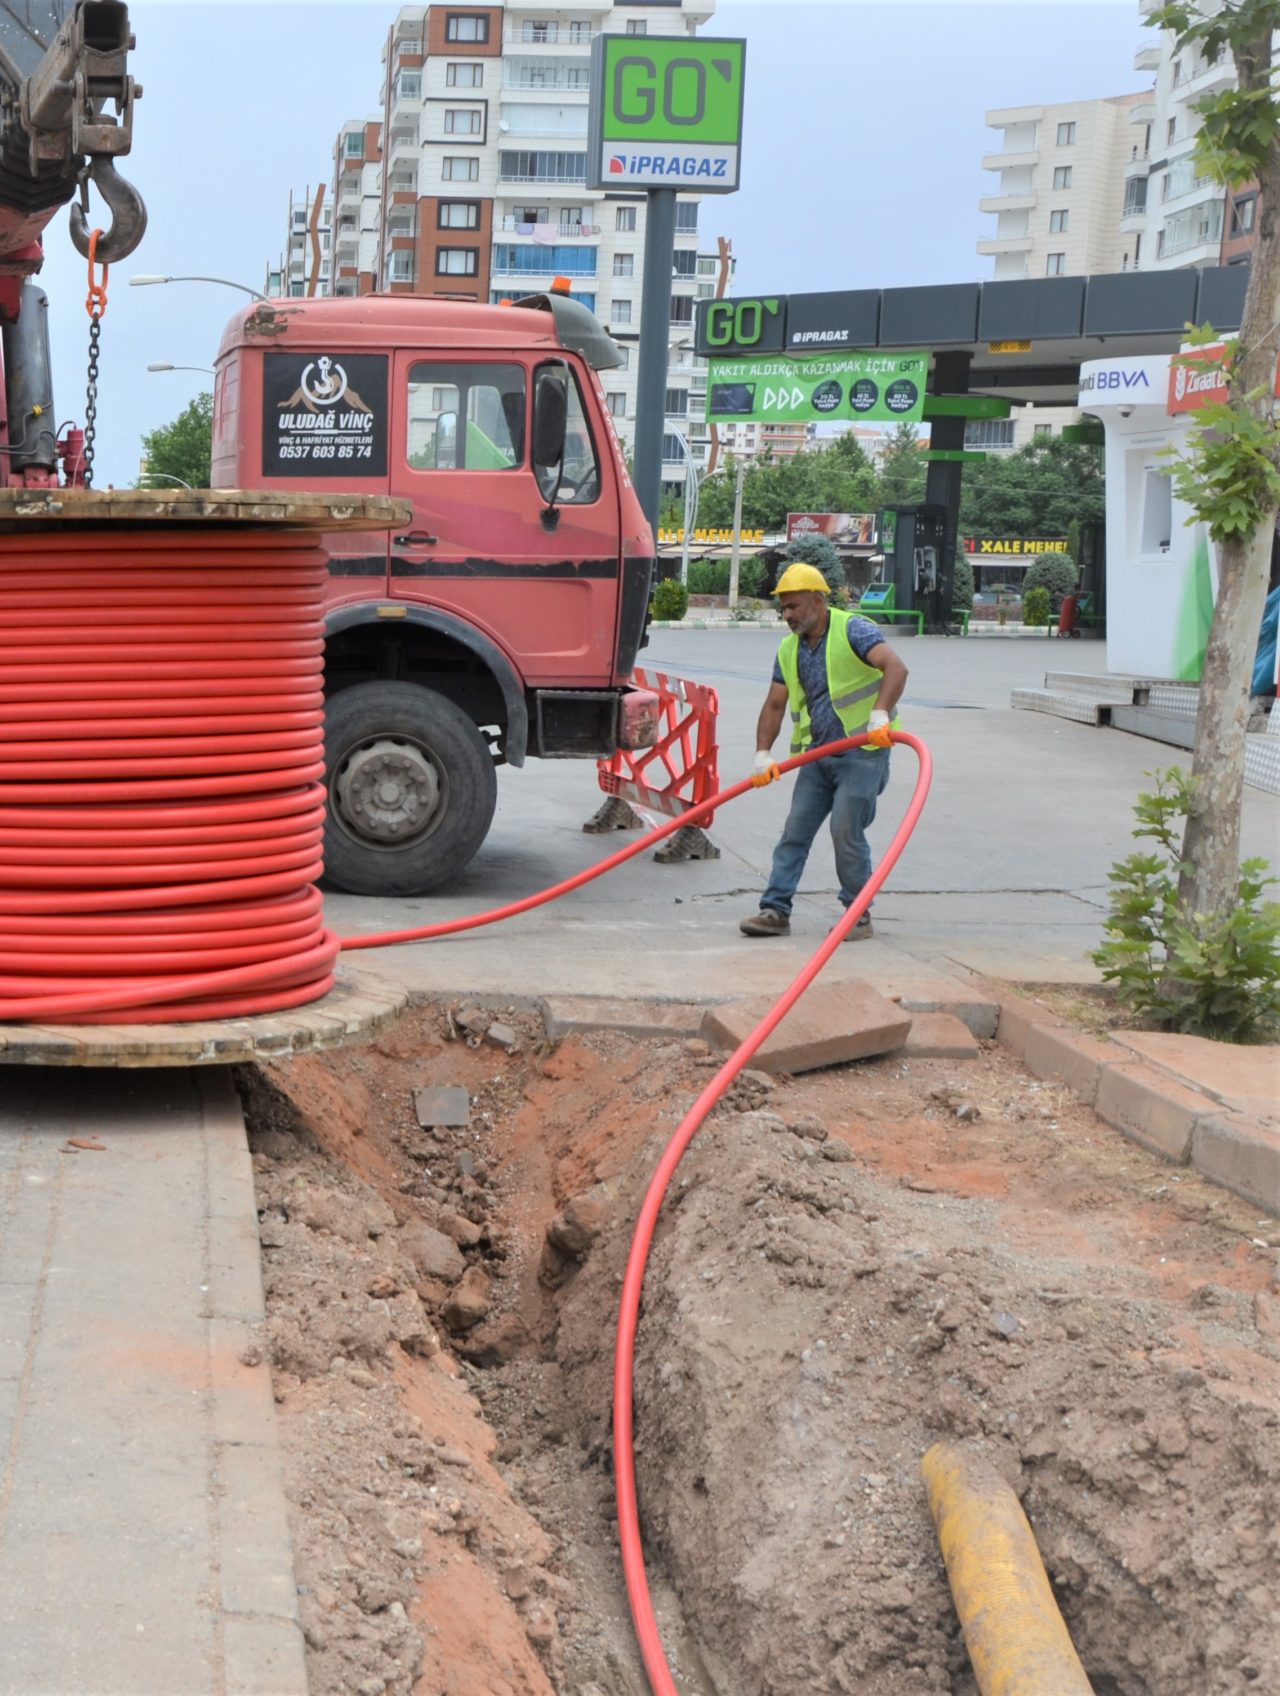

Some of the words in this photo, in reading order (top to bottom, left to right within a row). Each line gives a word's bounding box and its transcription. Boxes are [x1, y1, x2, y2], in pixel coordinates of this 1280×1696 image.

[613, 56, 706, 126] GO
[706, 300, 763, 346] GO
[802, 360, 860, 376] KAZANMAK
[1097, 370, 1150, 389] BBVA
[278, 410, 336, 429] ULUDAĞ
[339, 410, 374, 433] VİNÇ
[279, 446, 310, 458] 0537
[312, 446, 336, 458] 603
[338, 446, 353, 458] 85
[356, 446, 372, 458] 74
[980, 540, 1021, 553] XALE
